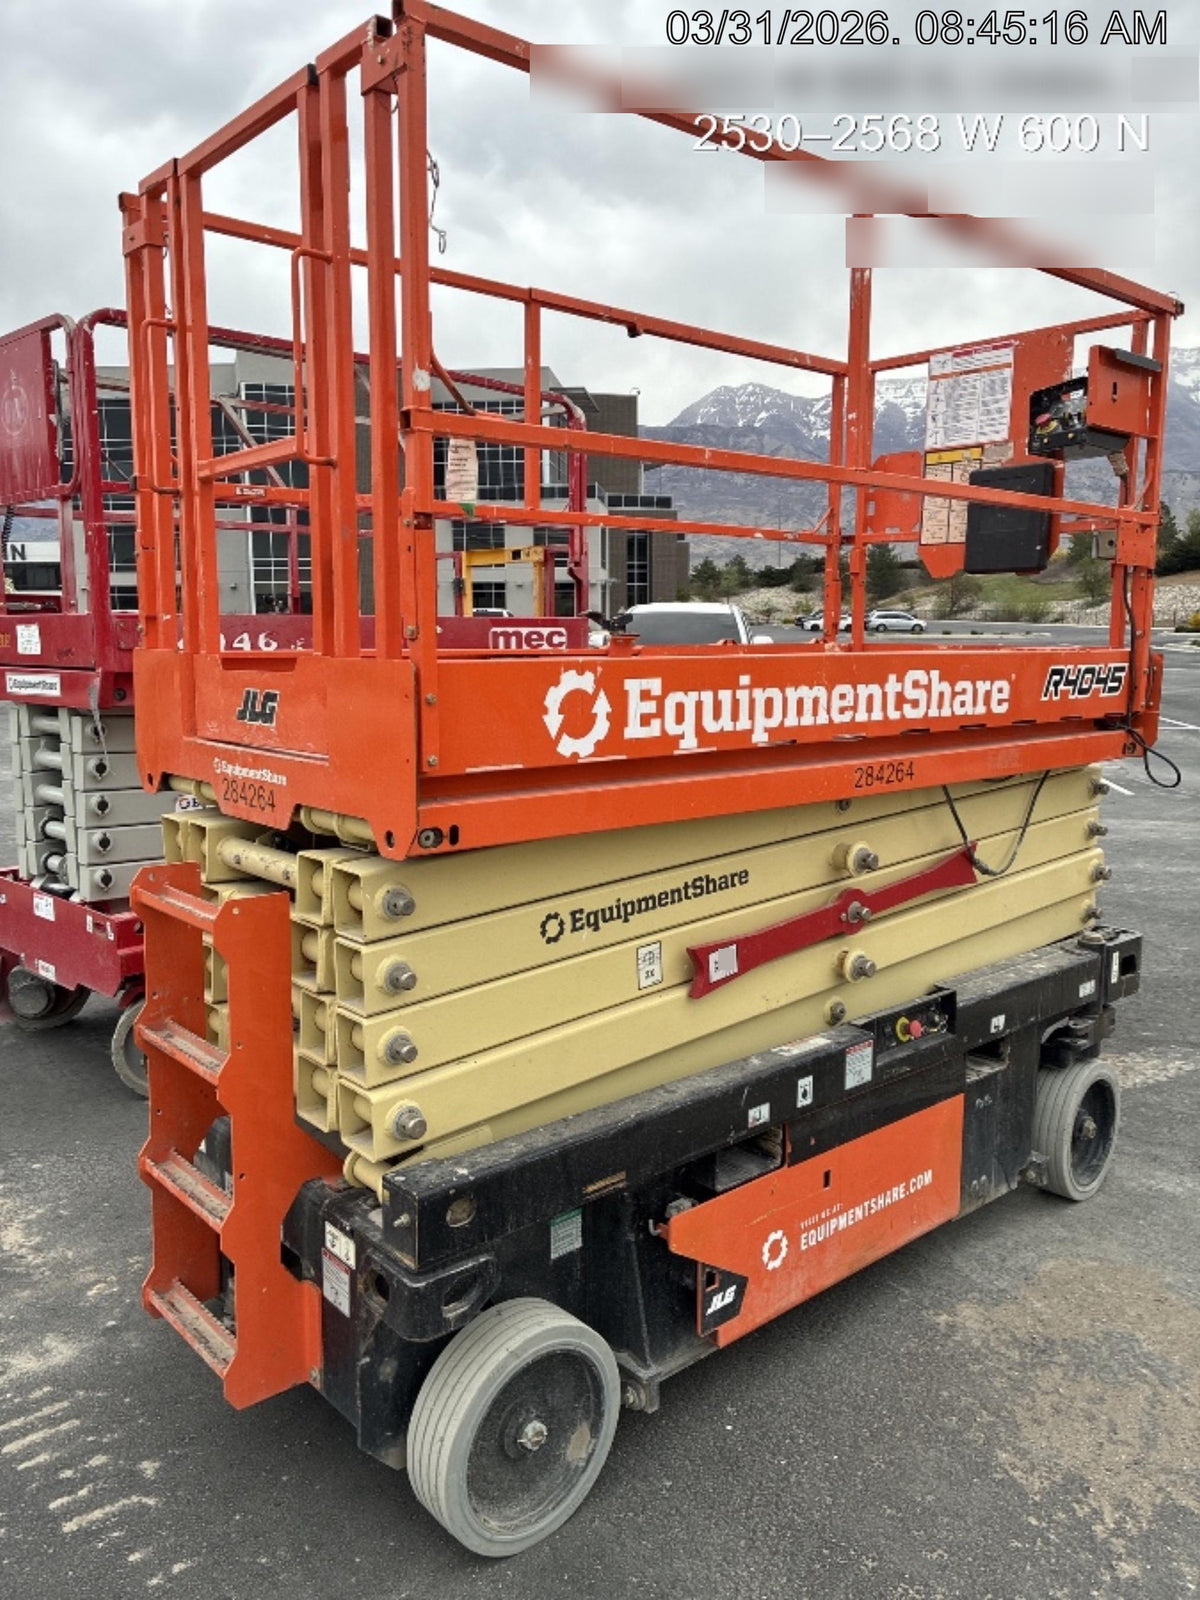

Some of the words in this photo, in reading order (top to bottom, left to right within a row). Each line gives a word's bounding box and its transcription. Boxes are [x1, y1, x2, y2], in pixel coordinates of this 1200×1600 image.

[1041, 663, 1129, 701] R4045
[236, 688, 280, 726] JLG
[623, 669, 1011, 750] EquipmentShare
[854, 760, 916, 789] 284264
[222, 778, 277, 813] 284264
[570, 869, 750, 934] EquipmentShare
[800, 1169, 933, 1250] EQUIPMENTSHARE.COM
[705, 1285, 737, 1316] JLG
